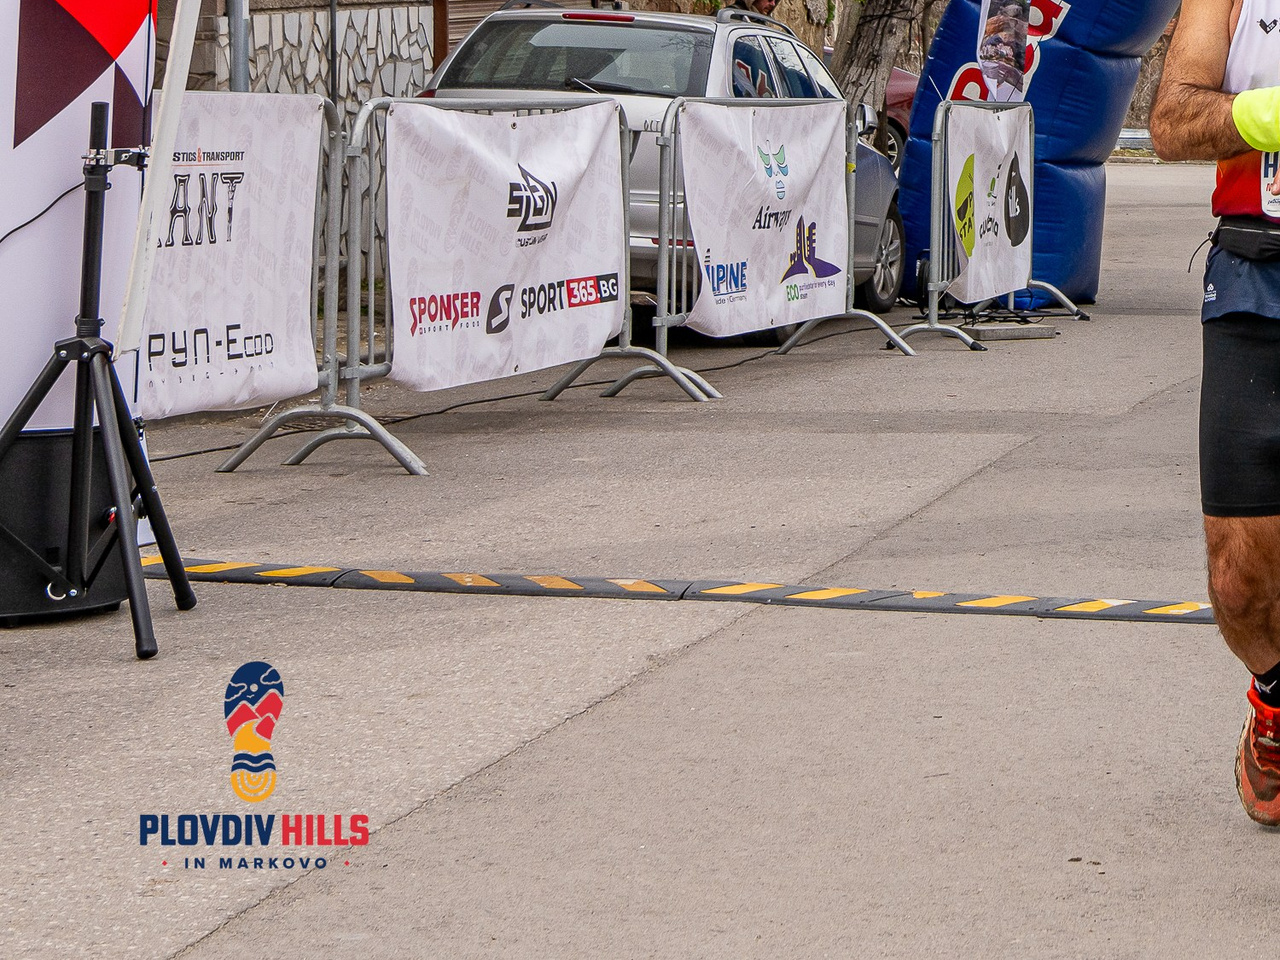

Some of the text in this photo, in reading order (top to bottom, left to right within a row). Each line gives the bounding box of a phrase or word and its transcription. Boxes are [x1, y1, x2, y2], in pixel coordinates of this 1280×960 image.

[157, 172, 245, 248] ANT
[409, 291, 482, 338] SPONSER
[785, 284, 800, 302] ECO
